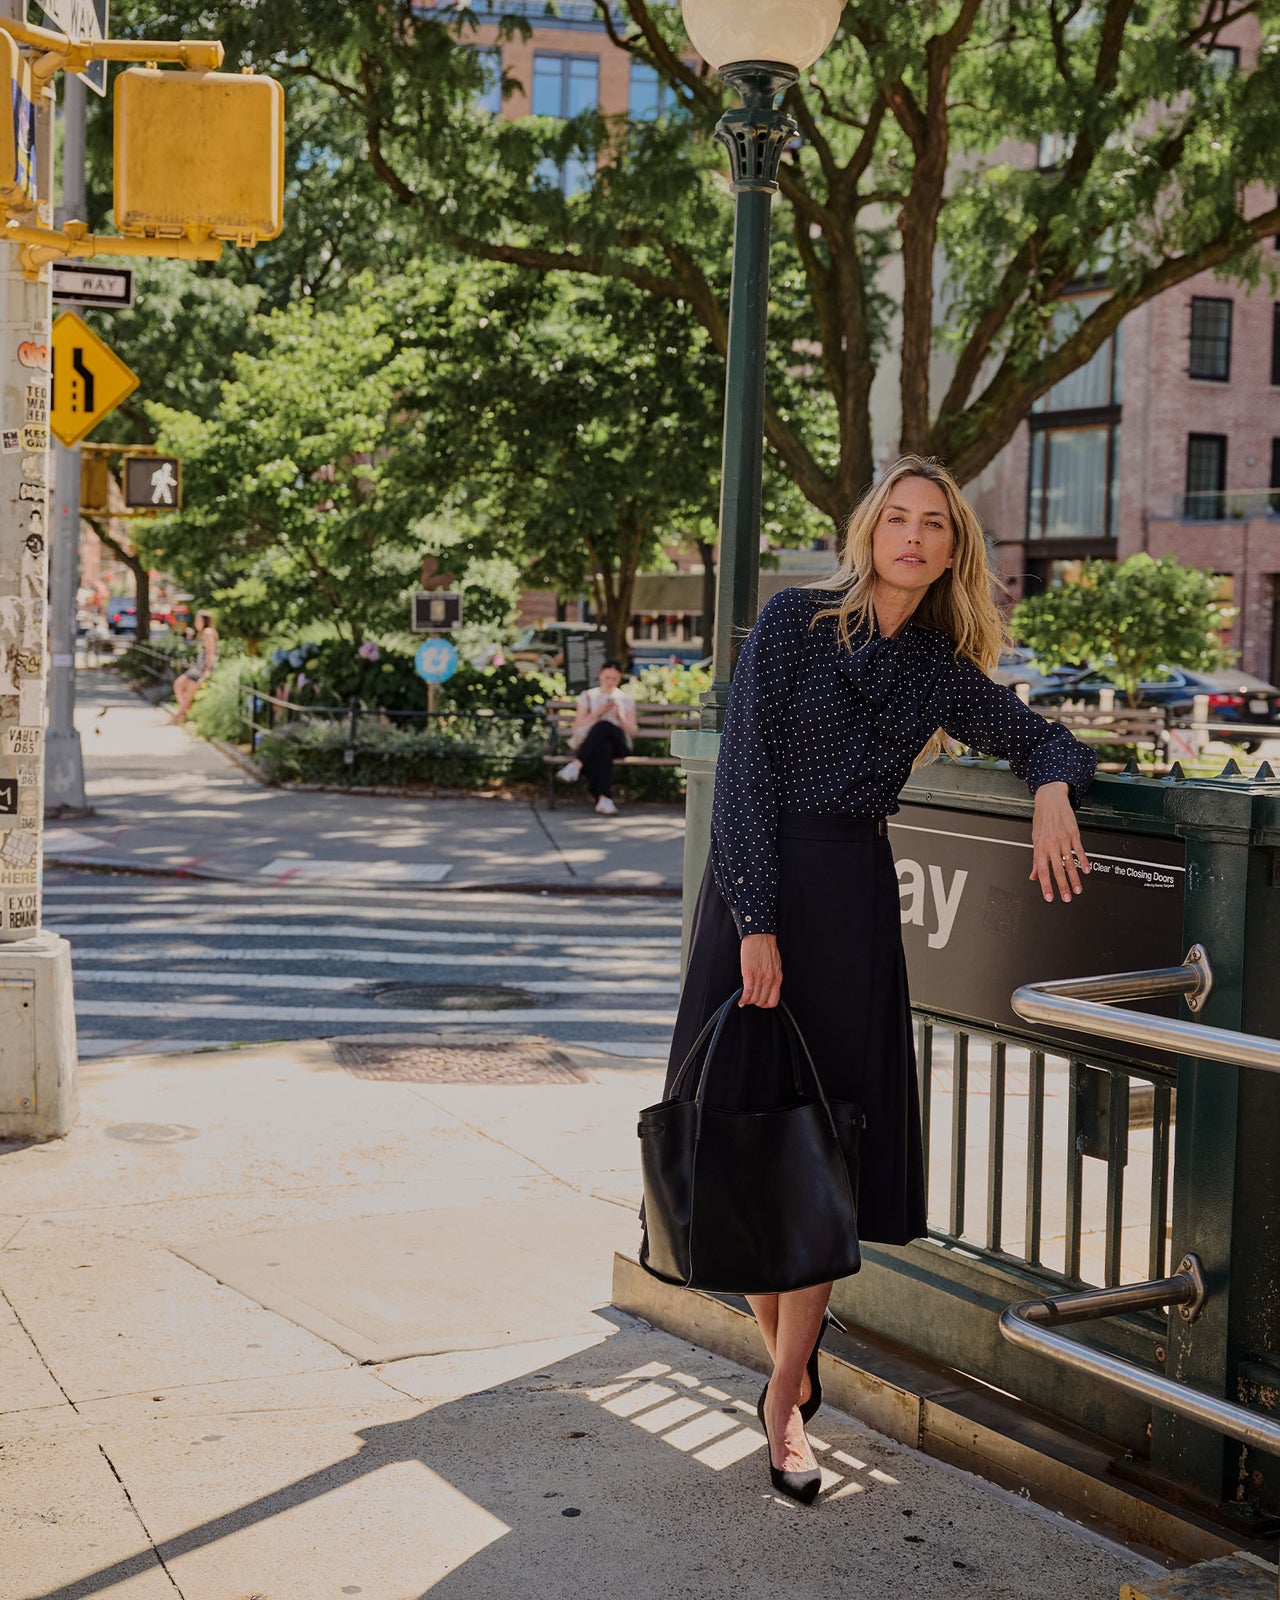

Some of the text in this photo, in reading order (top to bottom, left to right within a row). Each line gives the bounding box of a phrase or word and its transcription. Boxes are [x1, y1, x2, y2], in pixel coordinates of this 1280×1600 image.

[83, 278, 116, 290] WAY
[9, 729, 39, 742] VAULT
[14, 743, 34, 754] D65
[1, 872, 37, 884] HERE
[1114, 866, 1126, 876] the
[1126, 867, 1152, 882] Closing
[1153, 872, 1174, 884] Doors
